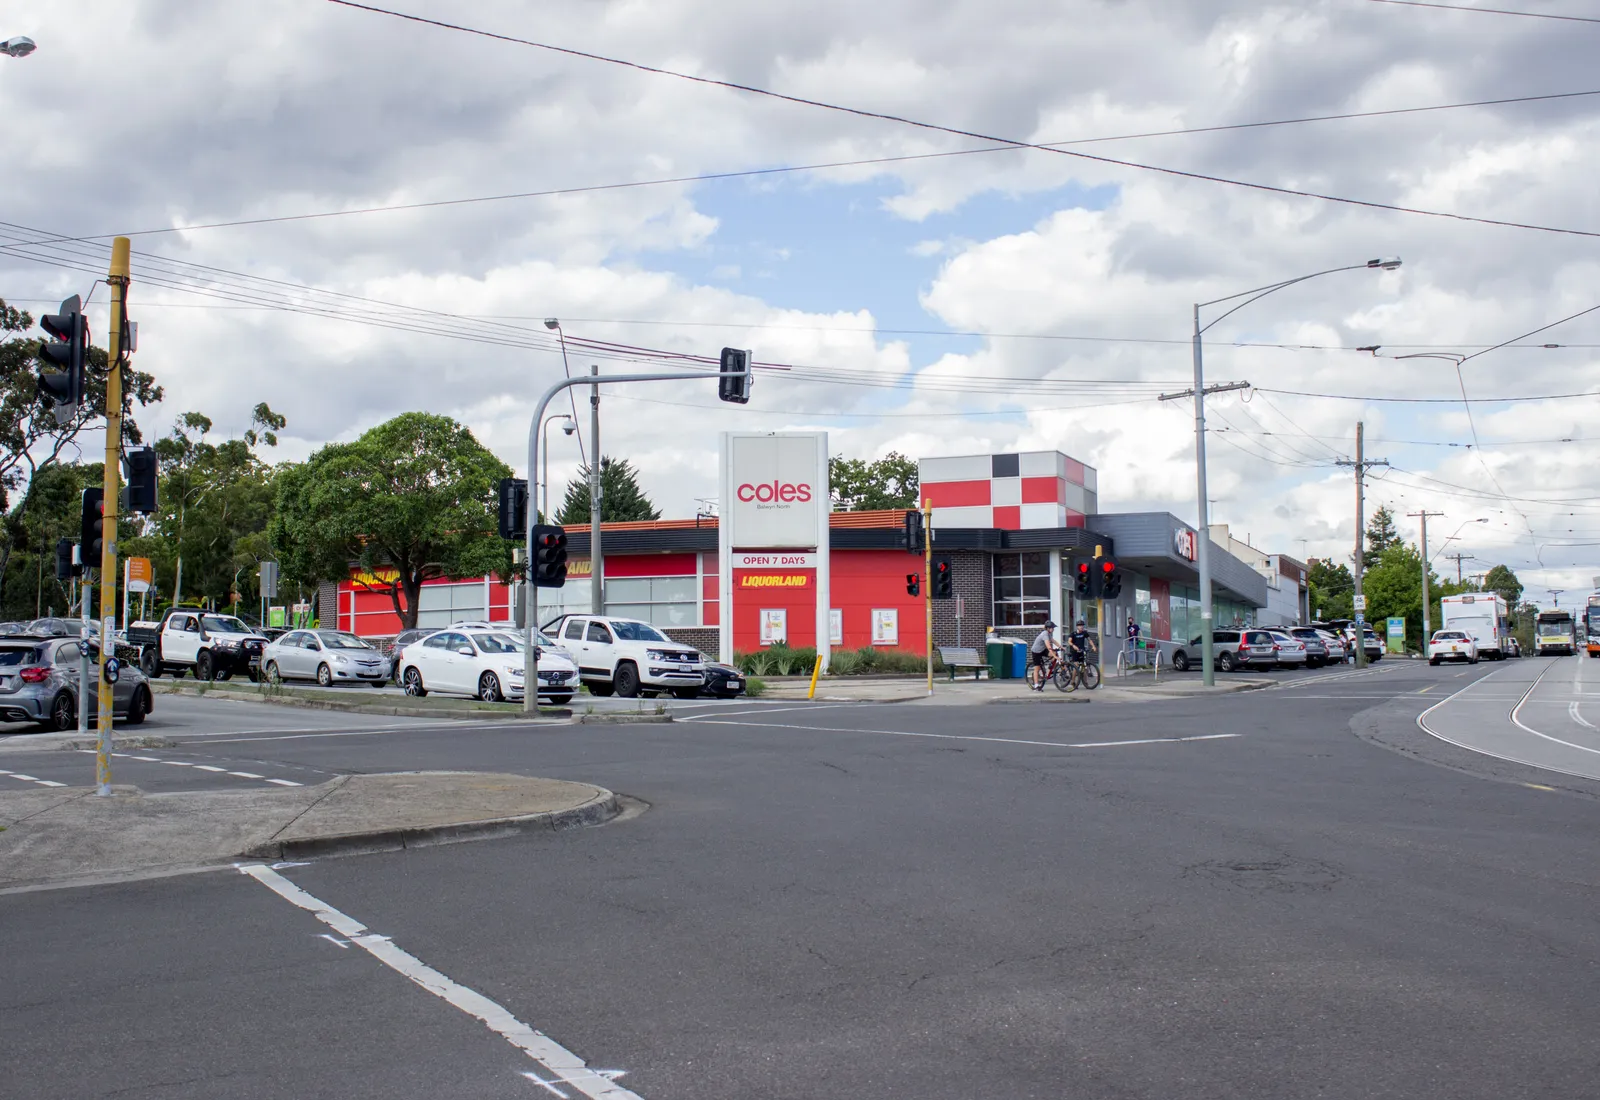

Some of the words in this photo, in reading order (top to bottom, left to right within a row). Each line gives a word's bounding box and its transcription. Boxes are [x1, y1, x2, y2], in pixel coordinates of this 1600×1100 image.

[737, 480, 811, 502] coles
[743, 556, 769, 565] OPEN
[773, 556, 778, 565] 7
[782, 556, 805, 565] DAYS
[742, 575, 806, 587] LIQUORLAND
